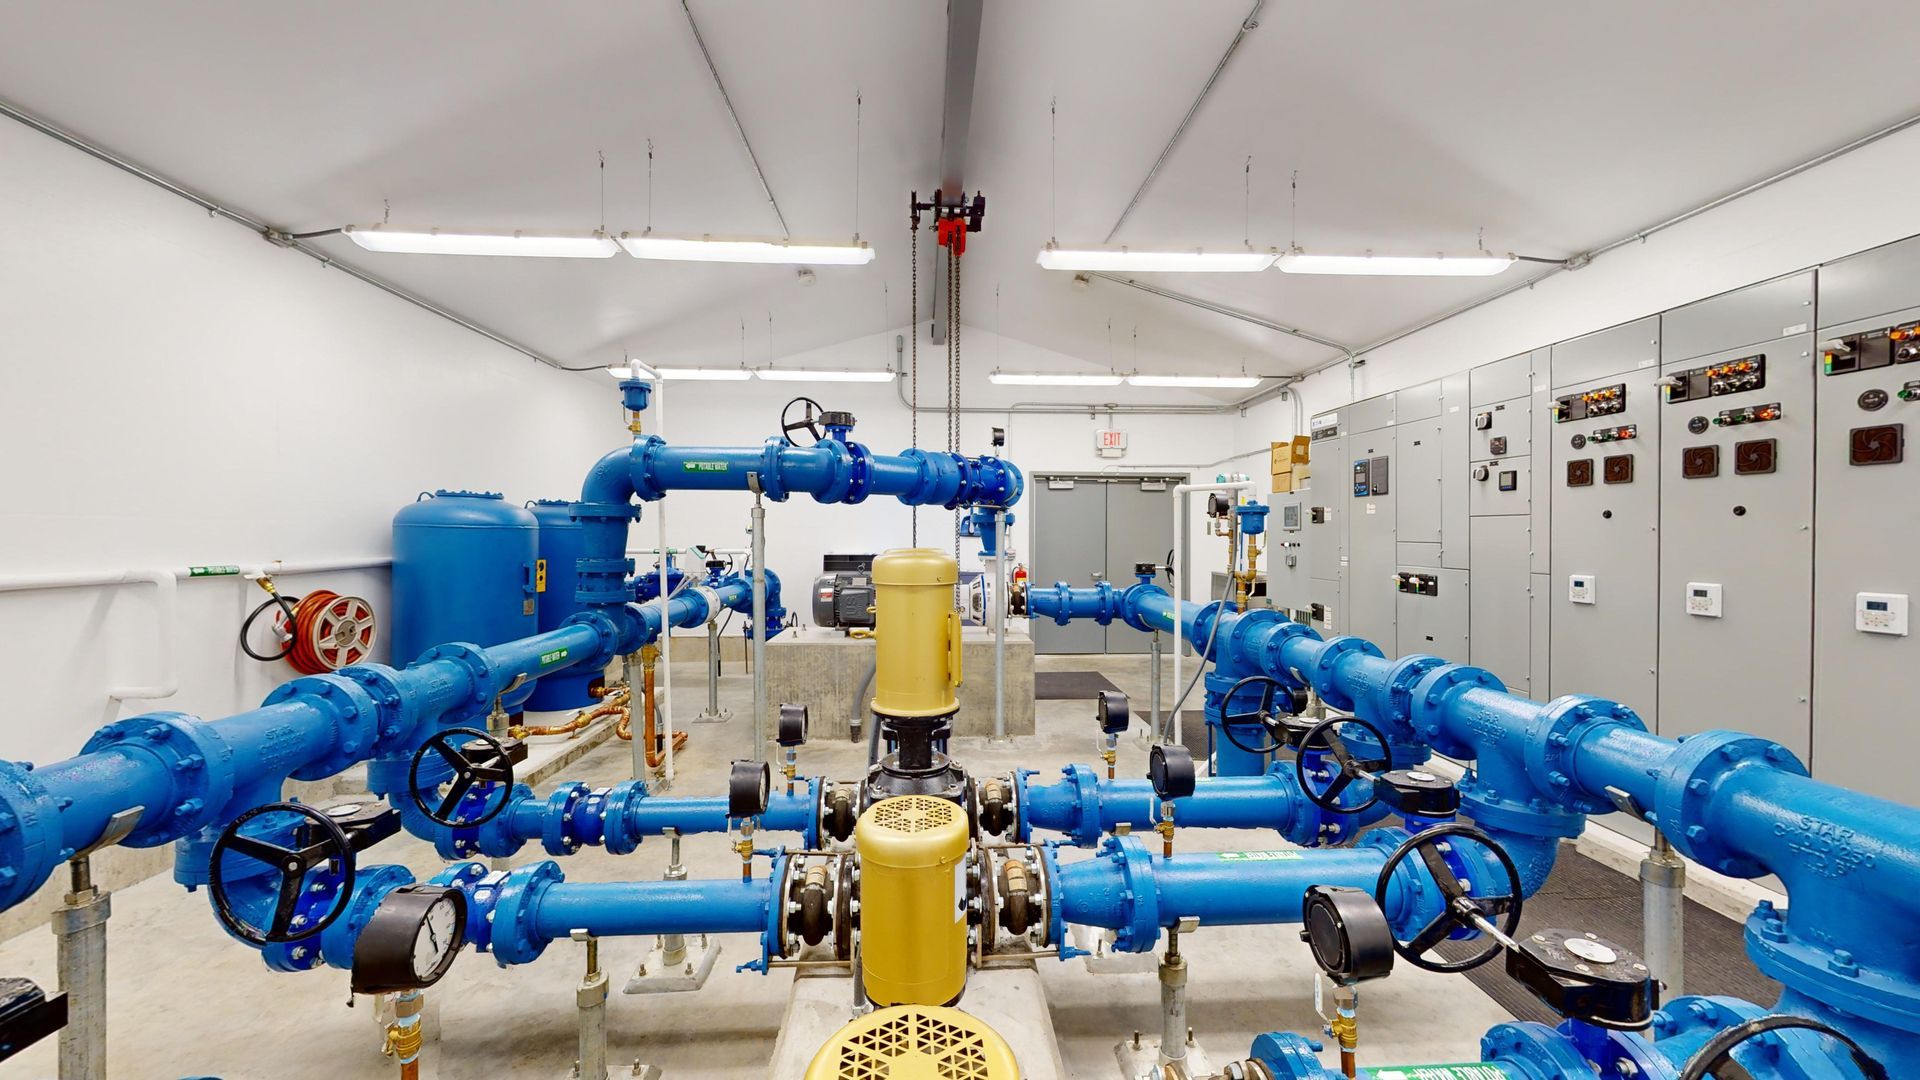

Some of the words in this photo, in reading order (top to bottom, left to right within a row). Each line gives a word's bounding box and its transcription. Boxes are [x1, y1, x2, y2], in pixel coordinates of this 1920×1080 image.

[1103, 431, 1121, 446] EXIT
[699, 462, 714, 471] POTABLE
[715, 462, 728, 471] WATER
[1800, 815, 1856, 844] STAR
